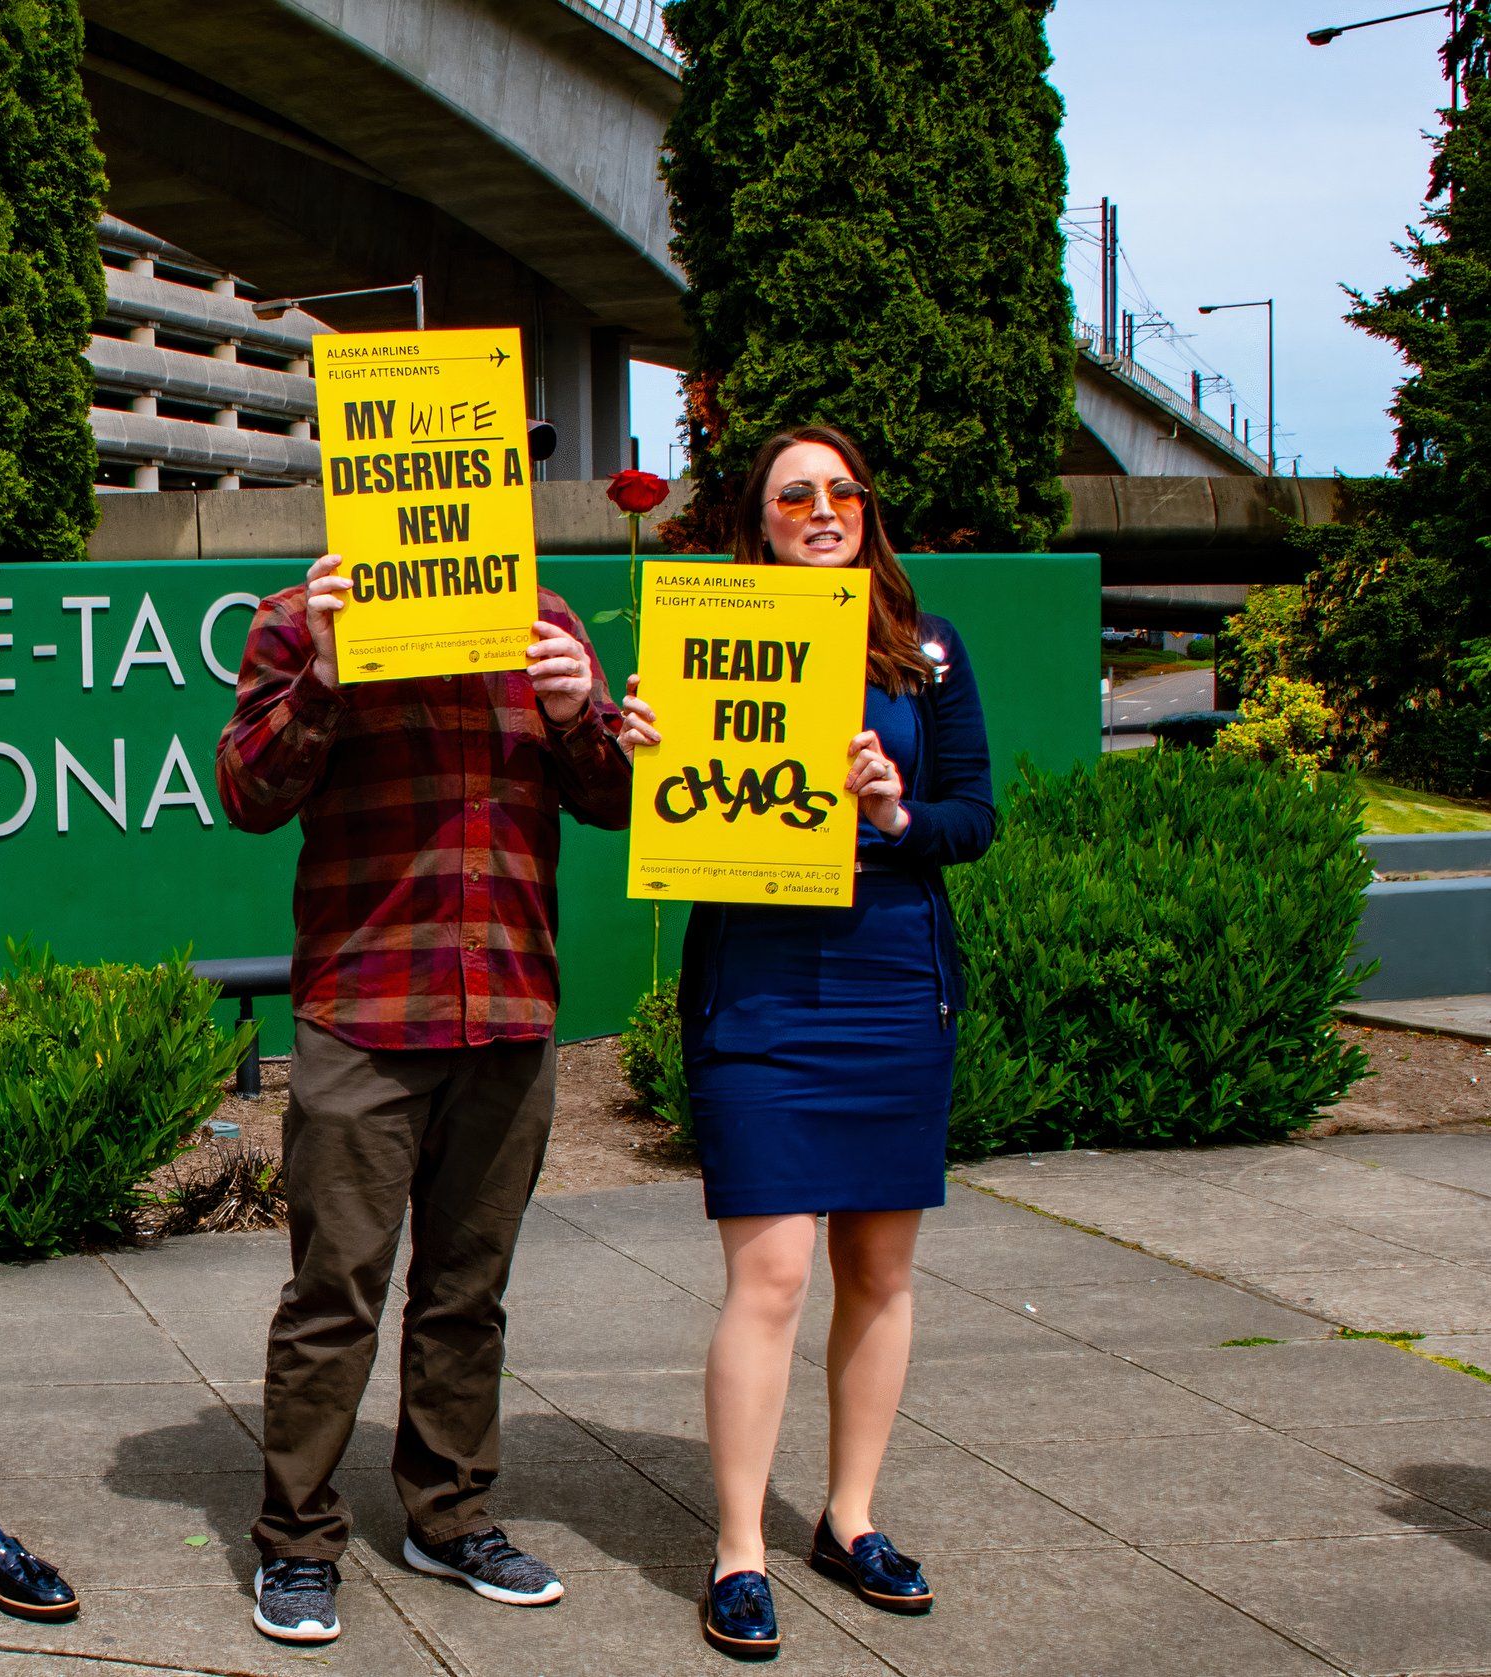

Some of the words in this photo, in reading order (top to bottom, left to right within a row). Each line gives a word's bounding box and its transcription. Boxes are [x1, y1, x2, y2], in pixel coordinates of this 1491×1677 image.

[327, 347, 369, 359] ALASKA
[371, 345, 420, 356] AIRLINES
[328, 368, 367, 380] FLIGHT
[369, 365, 440, 378] ATTENDANTS
[344, 400, 396, 441] MY
[410, 400, 497, 436] WIFE
[330, 449, 492, 496] DESERVES
[503, 447, 524, 487] A
[397, 503, 470, 546] NEW
[351, 553, 520, 604] CONTRACT
[655, 576, 701, 586] ALASKA
[703, 577, 756, 588] AIRLINES
[655, 596, 696, 606] FLIGHT
[698, 598, 775, 610] ATTENDANTS
[349, 645, 399, 656] Association
[400, 642, 409, 650] of
[411, 641, 435, 653] Flight
[483, 648, 526, 659] afaalaska.or
[683, 637, 810, 683] READY
[713, 699, 786, 743] FOR
[654, 758, 838, 832] CHAOS
[640, 864, 690, 874] Association
[692, 865, 701, 874] of
[703, 866, 726, 877] Flight
[782, 884, 840, 895] afaalaska.org
